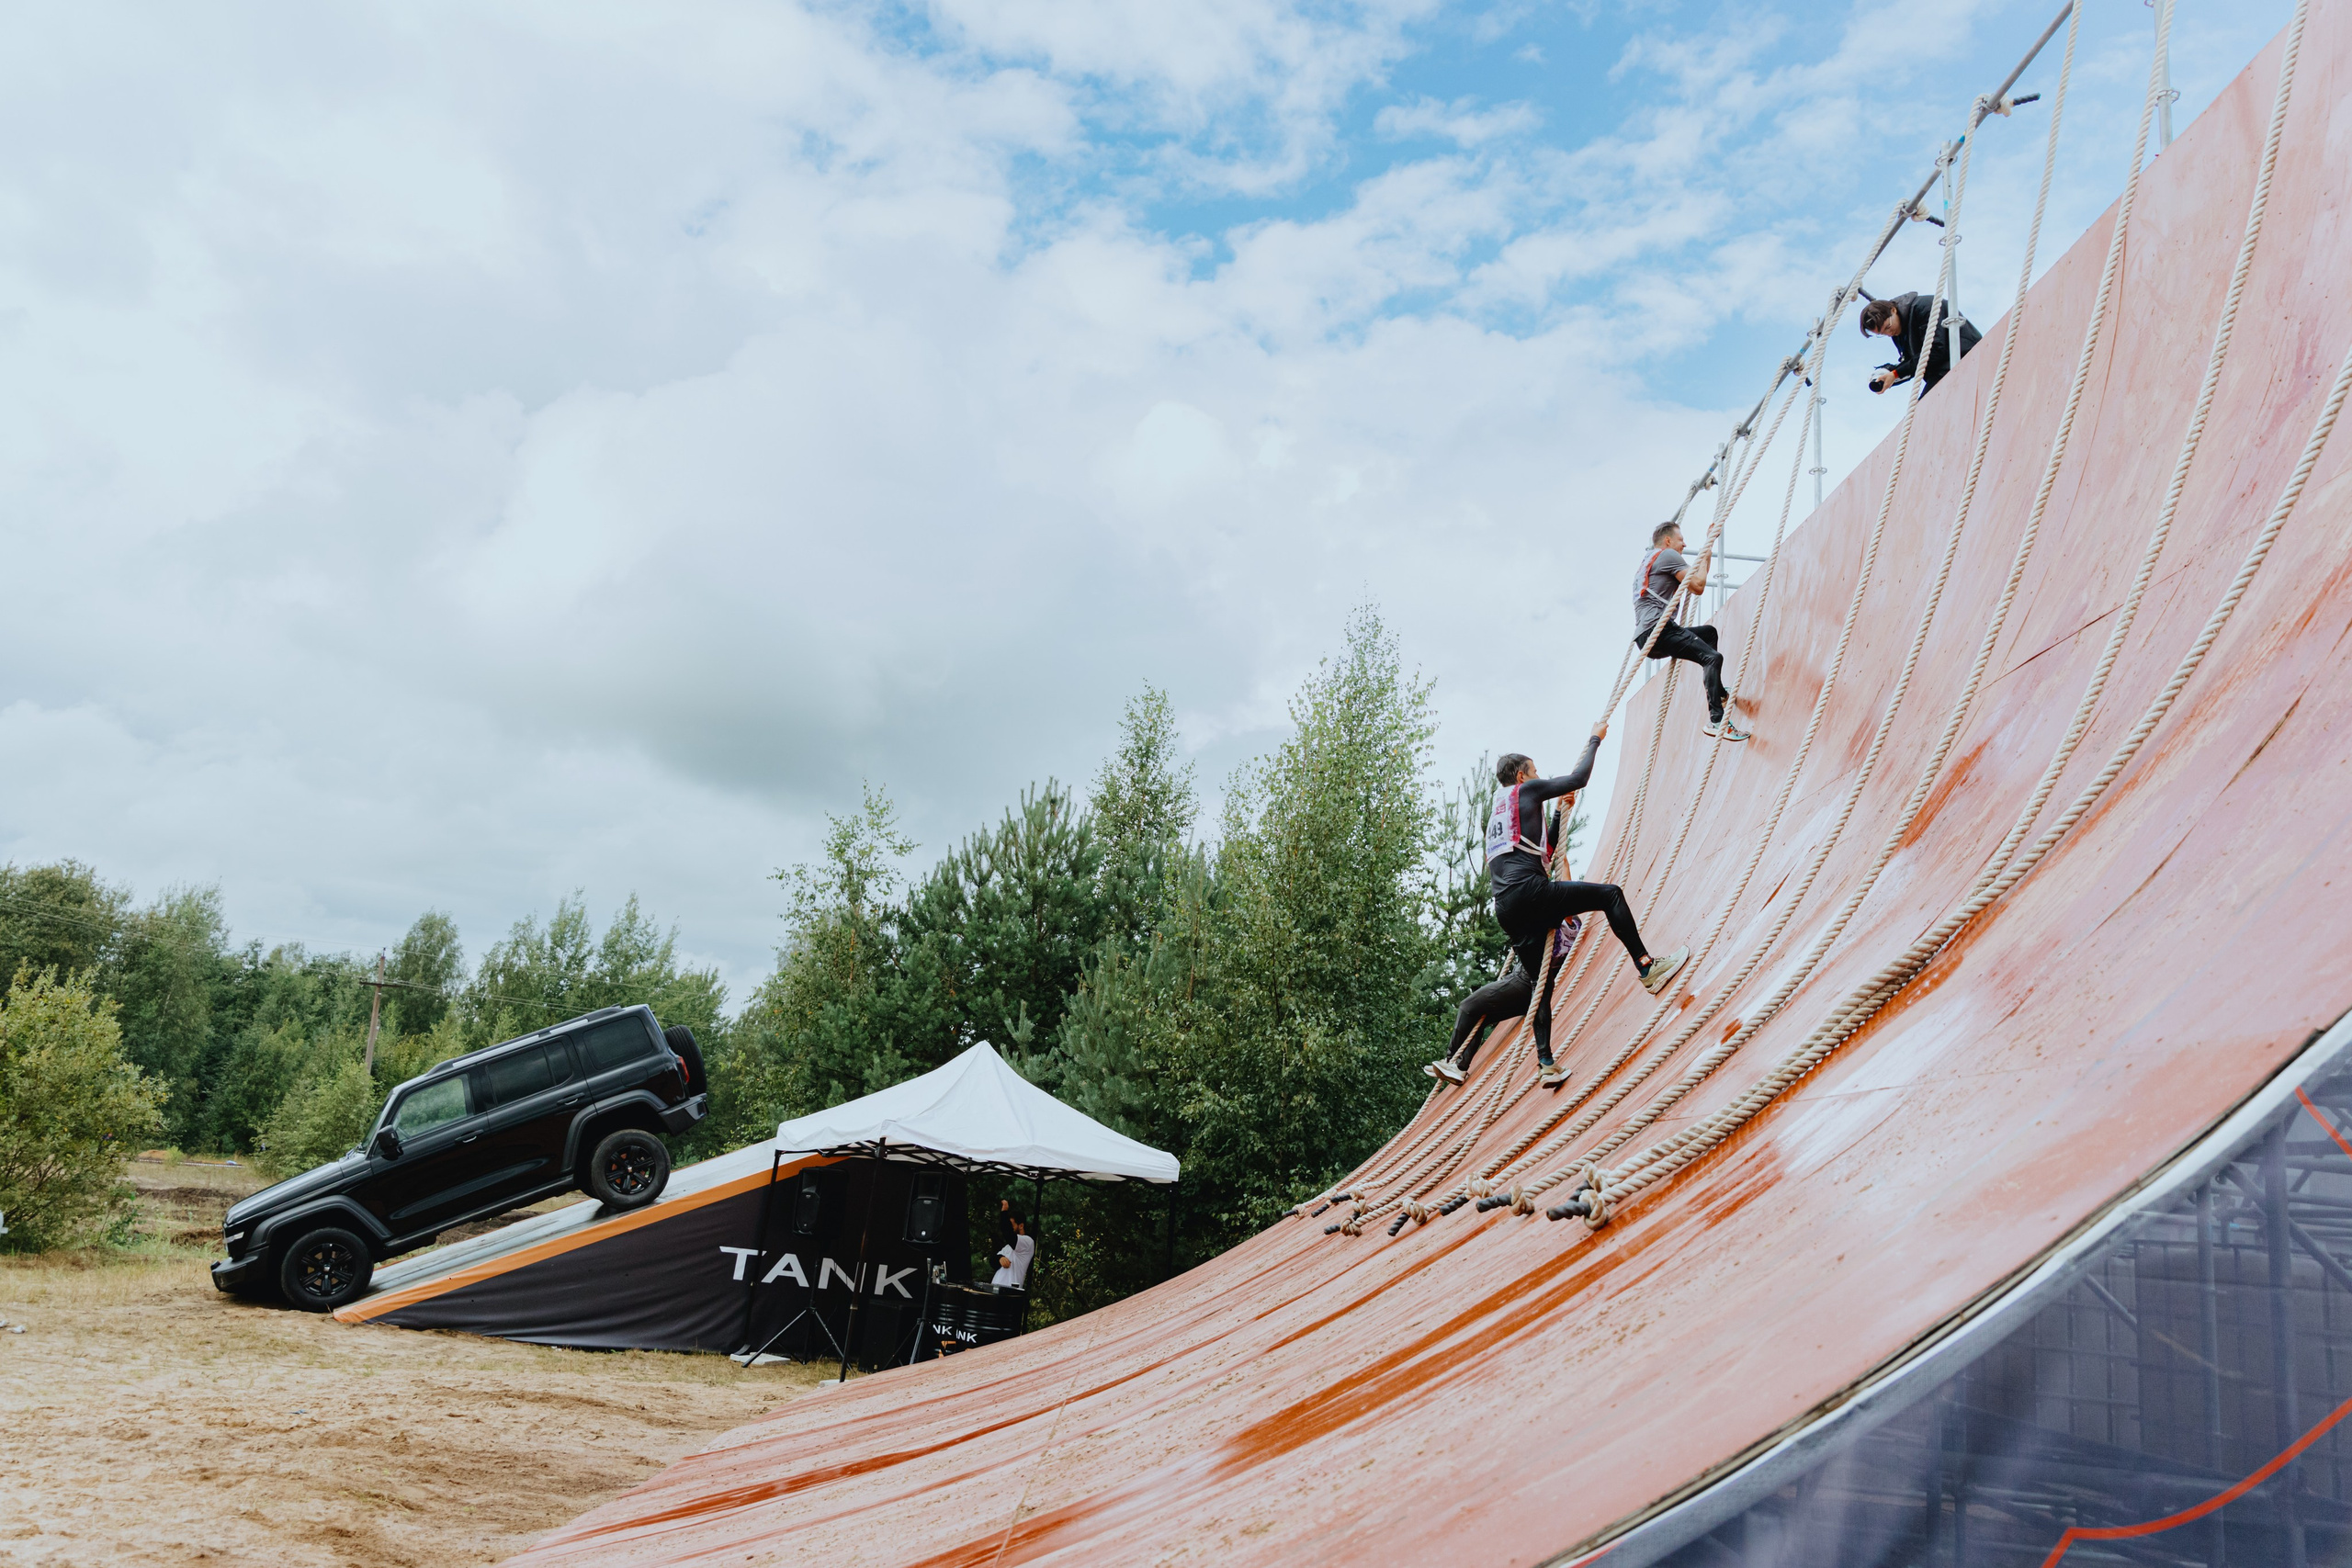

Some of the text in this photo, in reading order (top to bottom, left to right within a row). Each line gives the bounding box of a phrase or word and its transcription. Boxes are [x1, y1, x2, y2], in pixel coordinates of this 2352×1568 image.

[1487, 821, 1504, 840] 43
[718, 1246, 919, 1299] TANK
[933, 1324, 953, 1336] NK
[956, 1328, 978, 1343] NK
